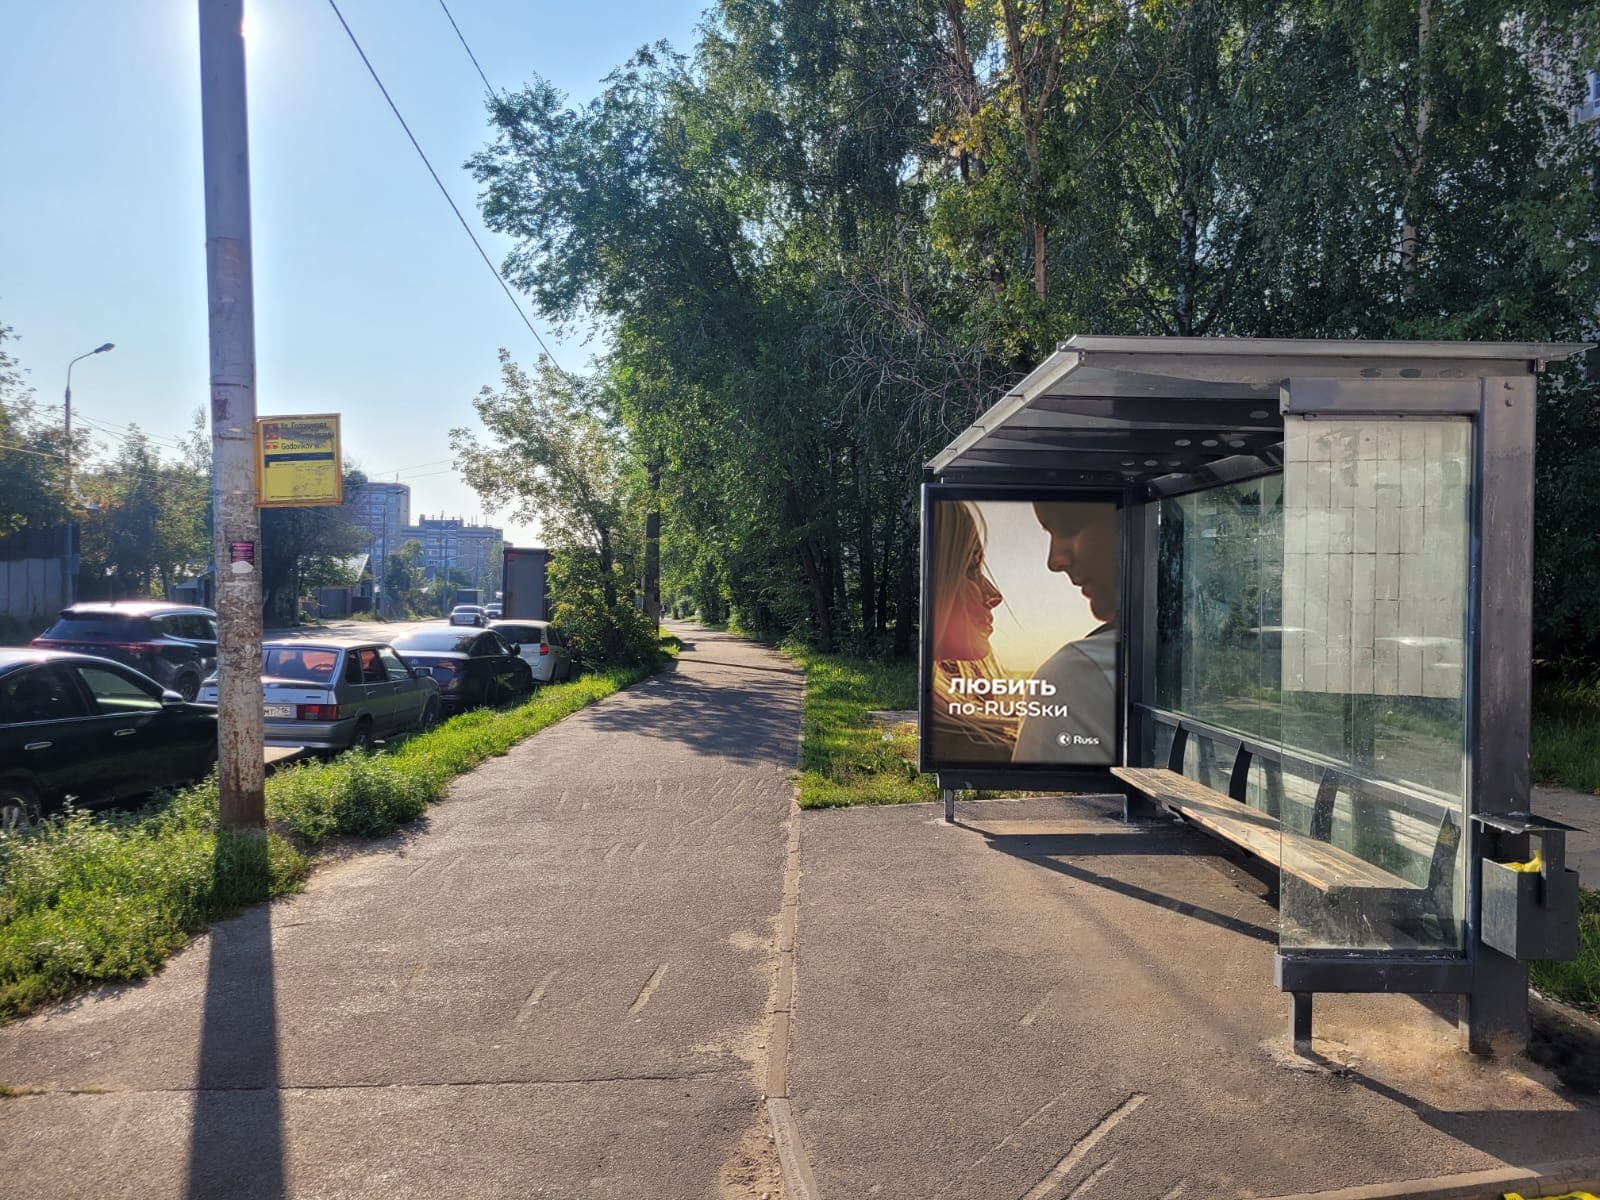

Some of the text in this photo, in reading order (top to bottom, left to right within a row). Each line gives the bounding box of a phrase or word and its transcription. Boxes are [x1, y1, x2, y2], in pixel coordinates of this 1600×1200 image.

[948, 677, 1057, 696] ЛЮБИТЬ
[948, 700, 1068, 718] по-RUSSки
[1073, 735, 1100, 745] Russ
